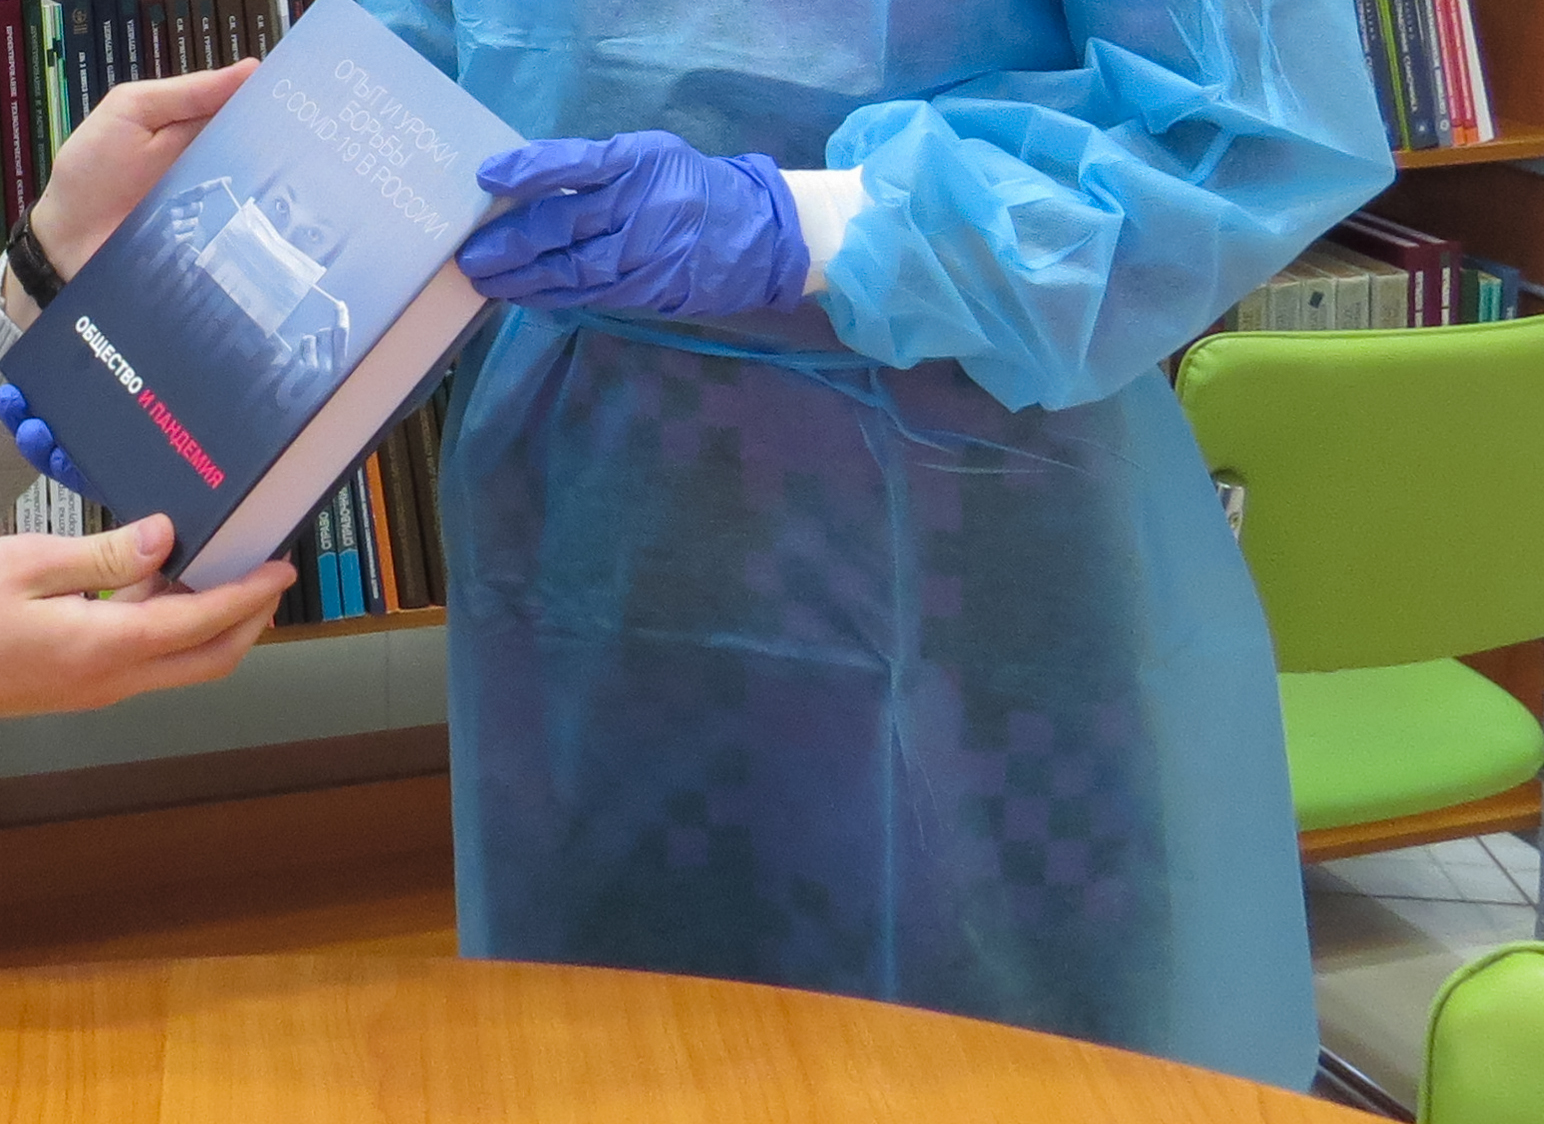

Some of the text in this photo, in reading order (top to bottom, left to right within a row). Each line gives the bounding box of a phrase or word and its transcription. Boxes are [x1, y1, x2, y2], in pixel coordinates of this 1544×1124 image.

[273, 79, 449, 240] С COVID-19 В РОССИИ
[335, 59, 458, 169] ОПЫТ И УРОКИ
[339, 100, 412, 167] БОРЬБЫ
[76, 315, 226, 489] ОБЩЕСТВО И ПАНДЕМИЯ
